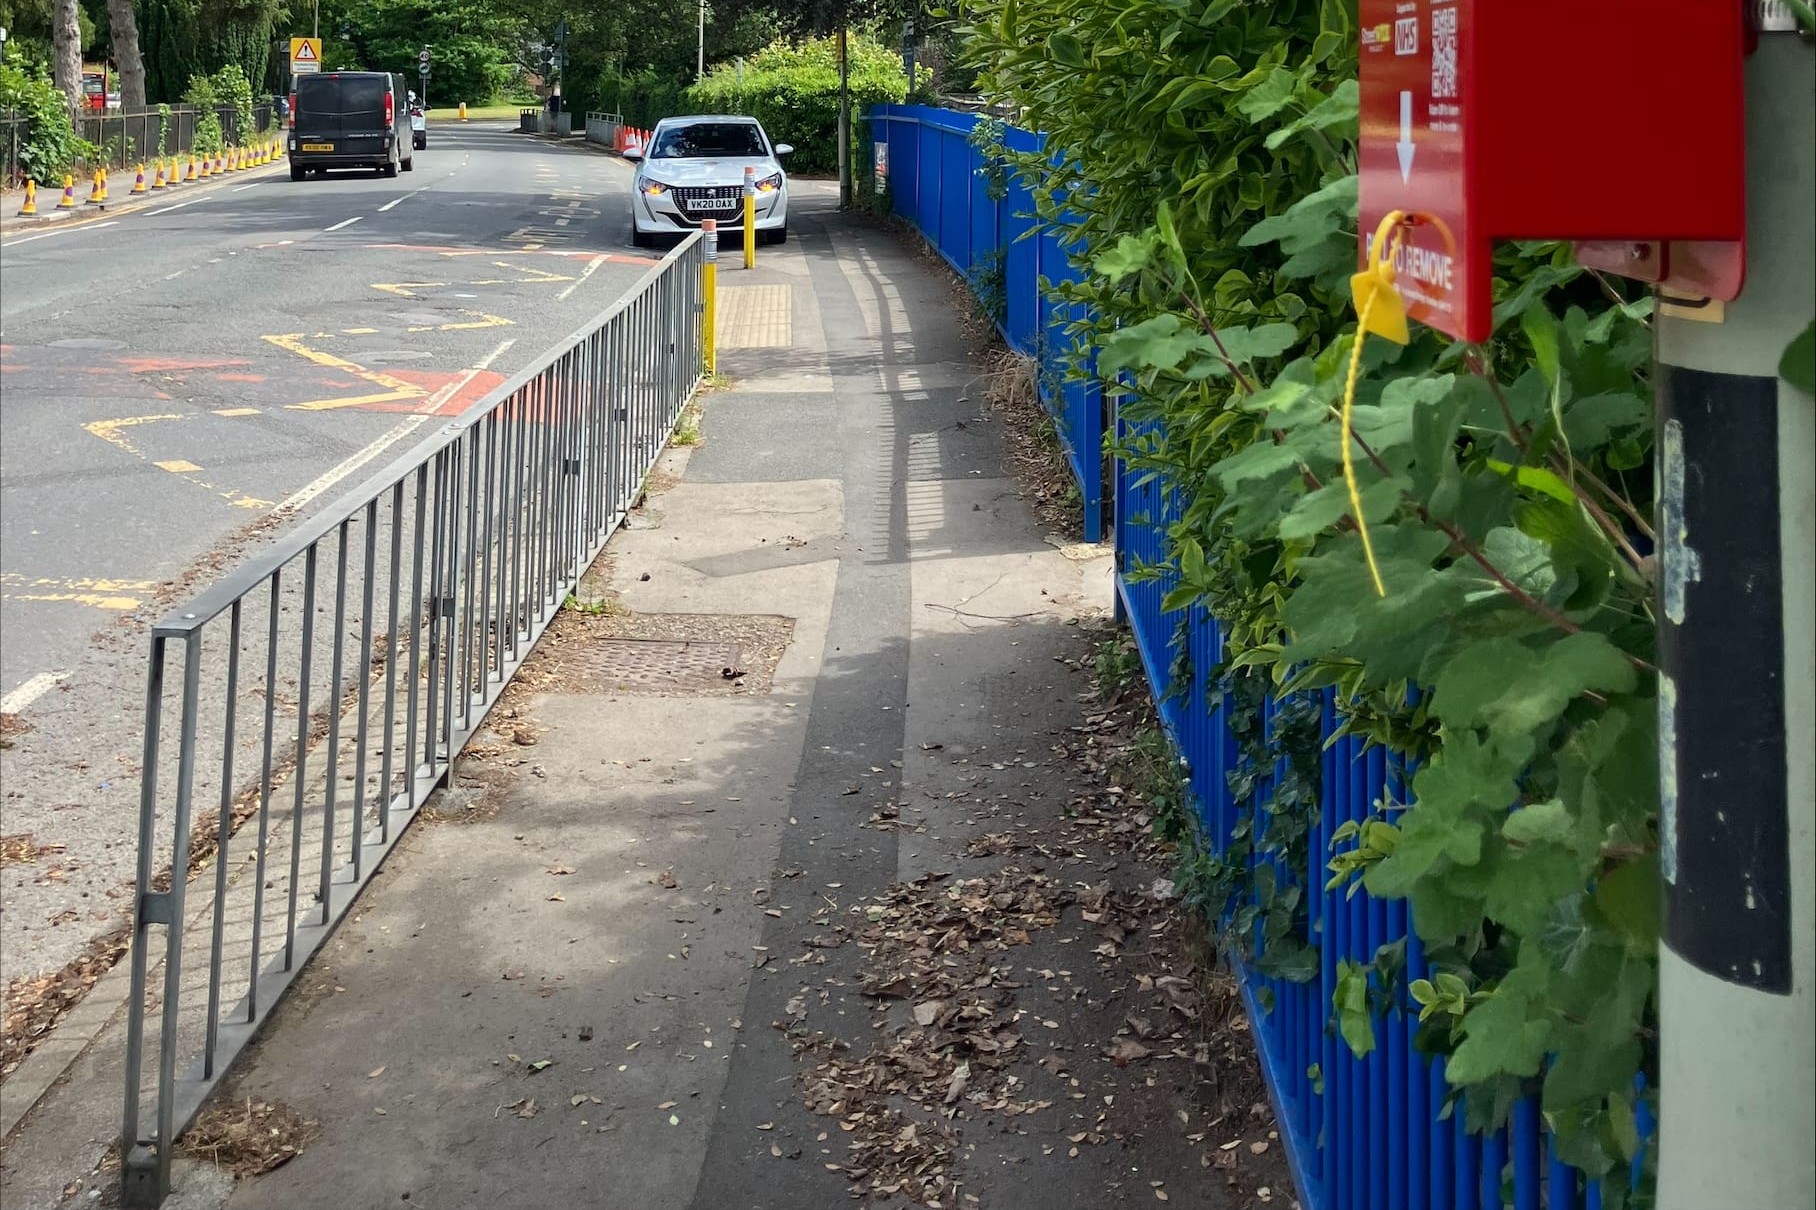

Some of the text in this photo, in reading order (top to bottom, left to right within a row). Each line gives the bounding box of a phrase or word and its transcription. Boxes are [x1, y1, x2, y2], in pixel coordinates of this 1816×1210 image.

[1396, 20, 1416, 52] NHS
[691, 199, 733, 209] VK20 OAX
[1406, 245, 1453, 292] REMOVE
